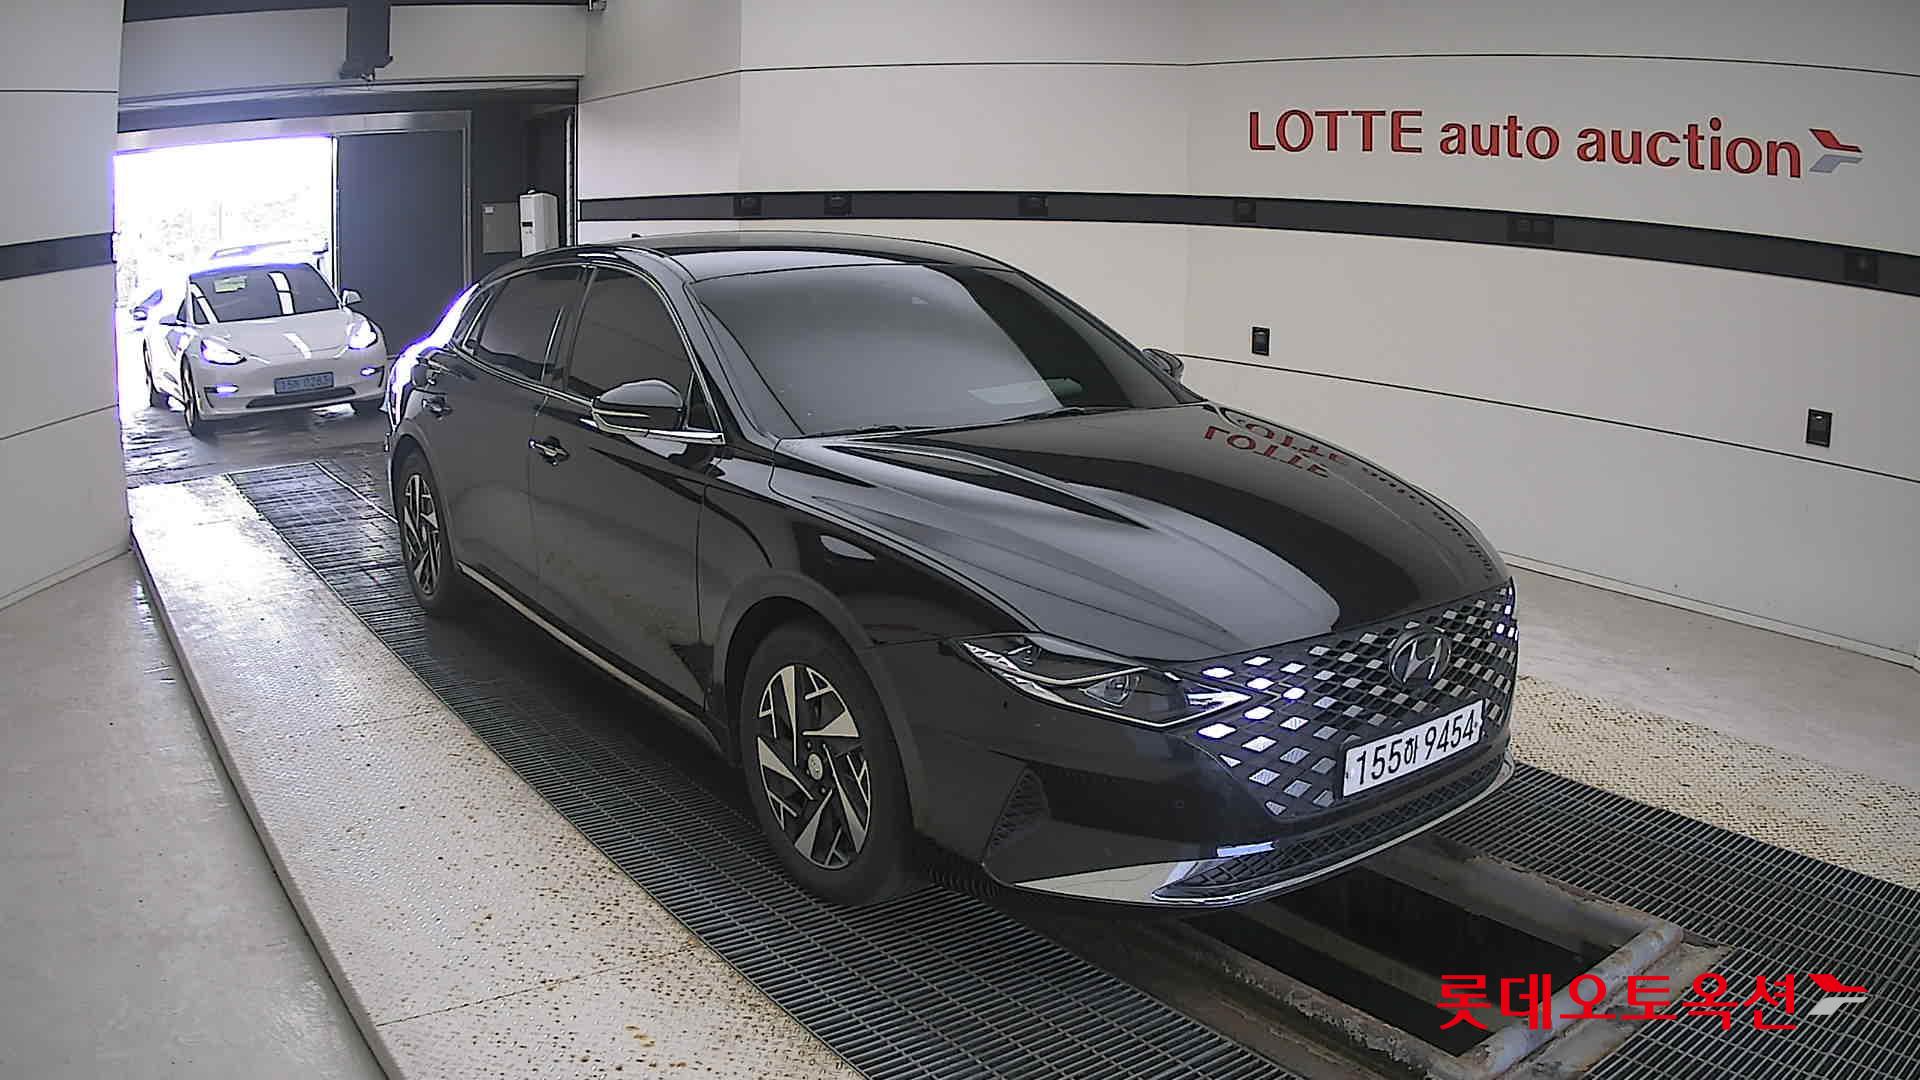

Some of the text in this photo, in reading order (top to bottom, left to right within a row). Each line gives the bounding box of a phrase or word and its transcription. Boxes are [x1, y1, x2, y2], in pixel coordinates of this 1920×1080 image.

[1249, 110, 1802, 178] LOTTE auto auction
[1356, 708, 1475, 785] 155하 9454
